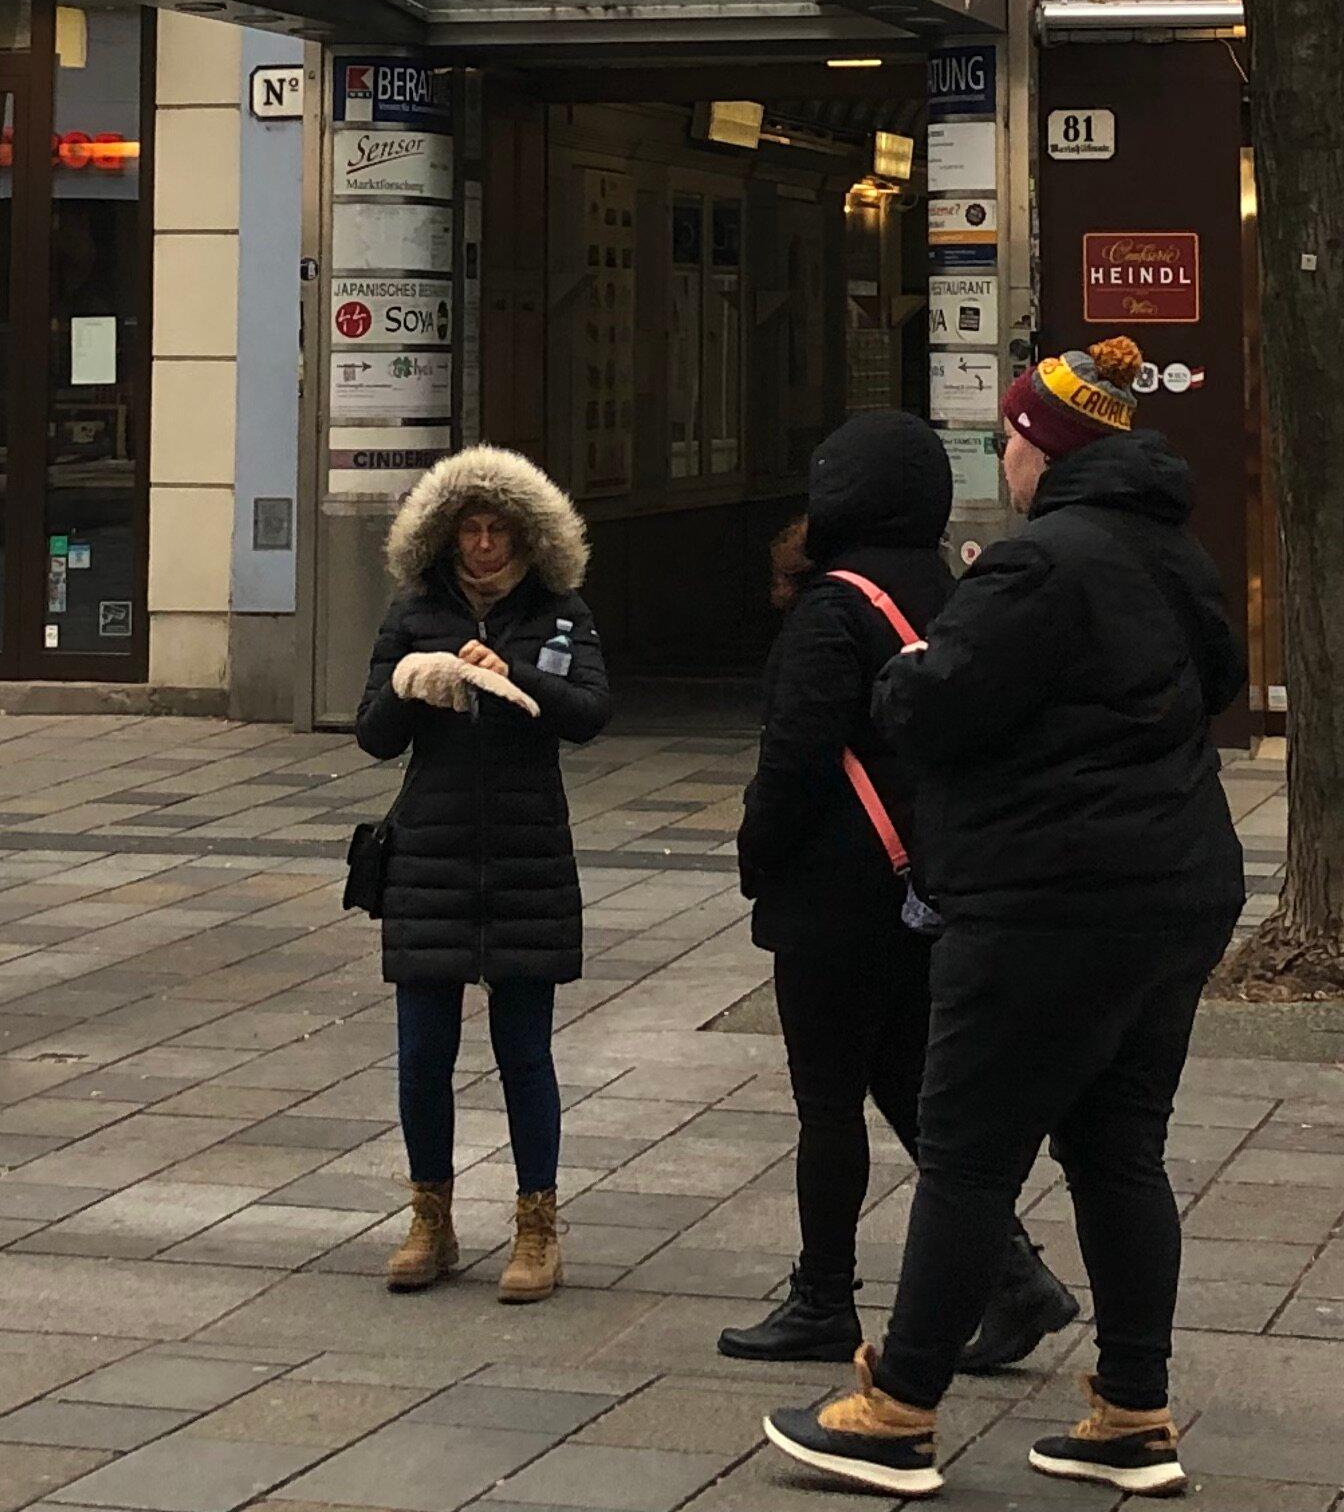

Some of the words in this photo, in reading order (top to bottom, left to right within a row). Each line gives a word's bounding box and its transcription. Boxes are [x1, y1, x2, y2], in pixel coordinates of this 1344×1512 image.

[929, 55, 986, 93] TUNG
[1063, 115, 1093, 142] 81
[347, 135, 425, 168] Sensor
[1090, 266, 1192, 284] HEINDL
[333, 283, 416, 297] JAPANISCHES
[385, 306, 434, 334] SOYA
